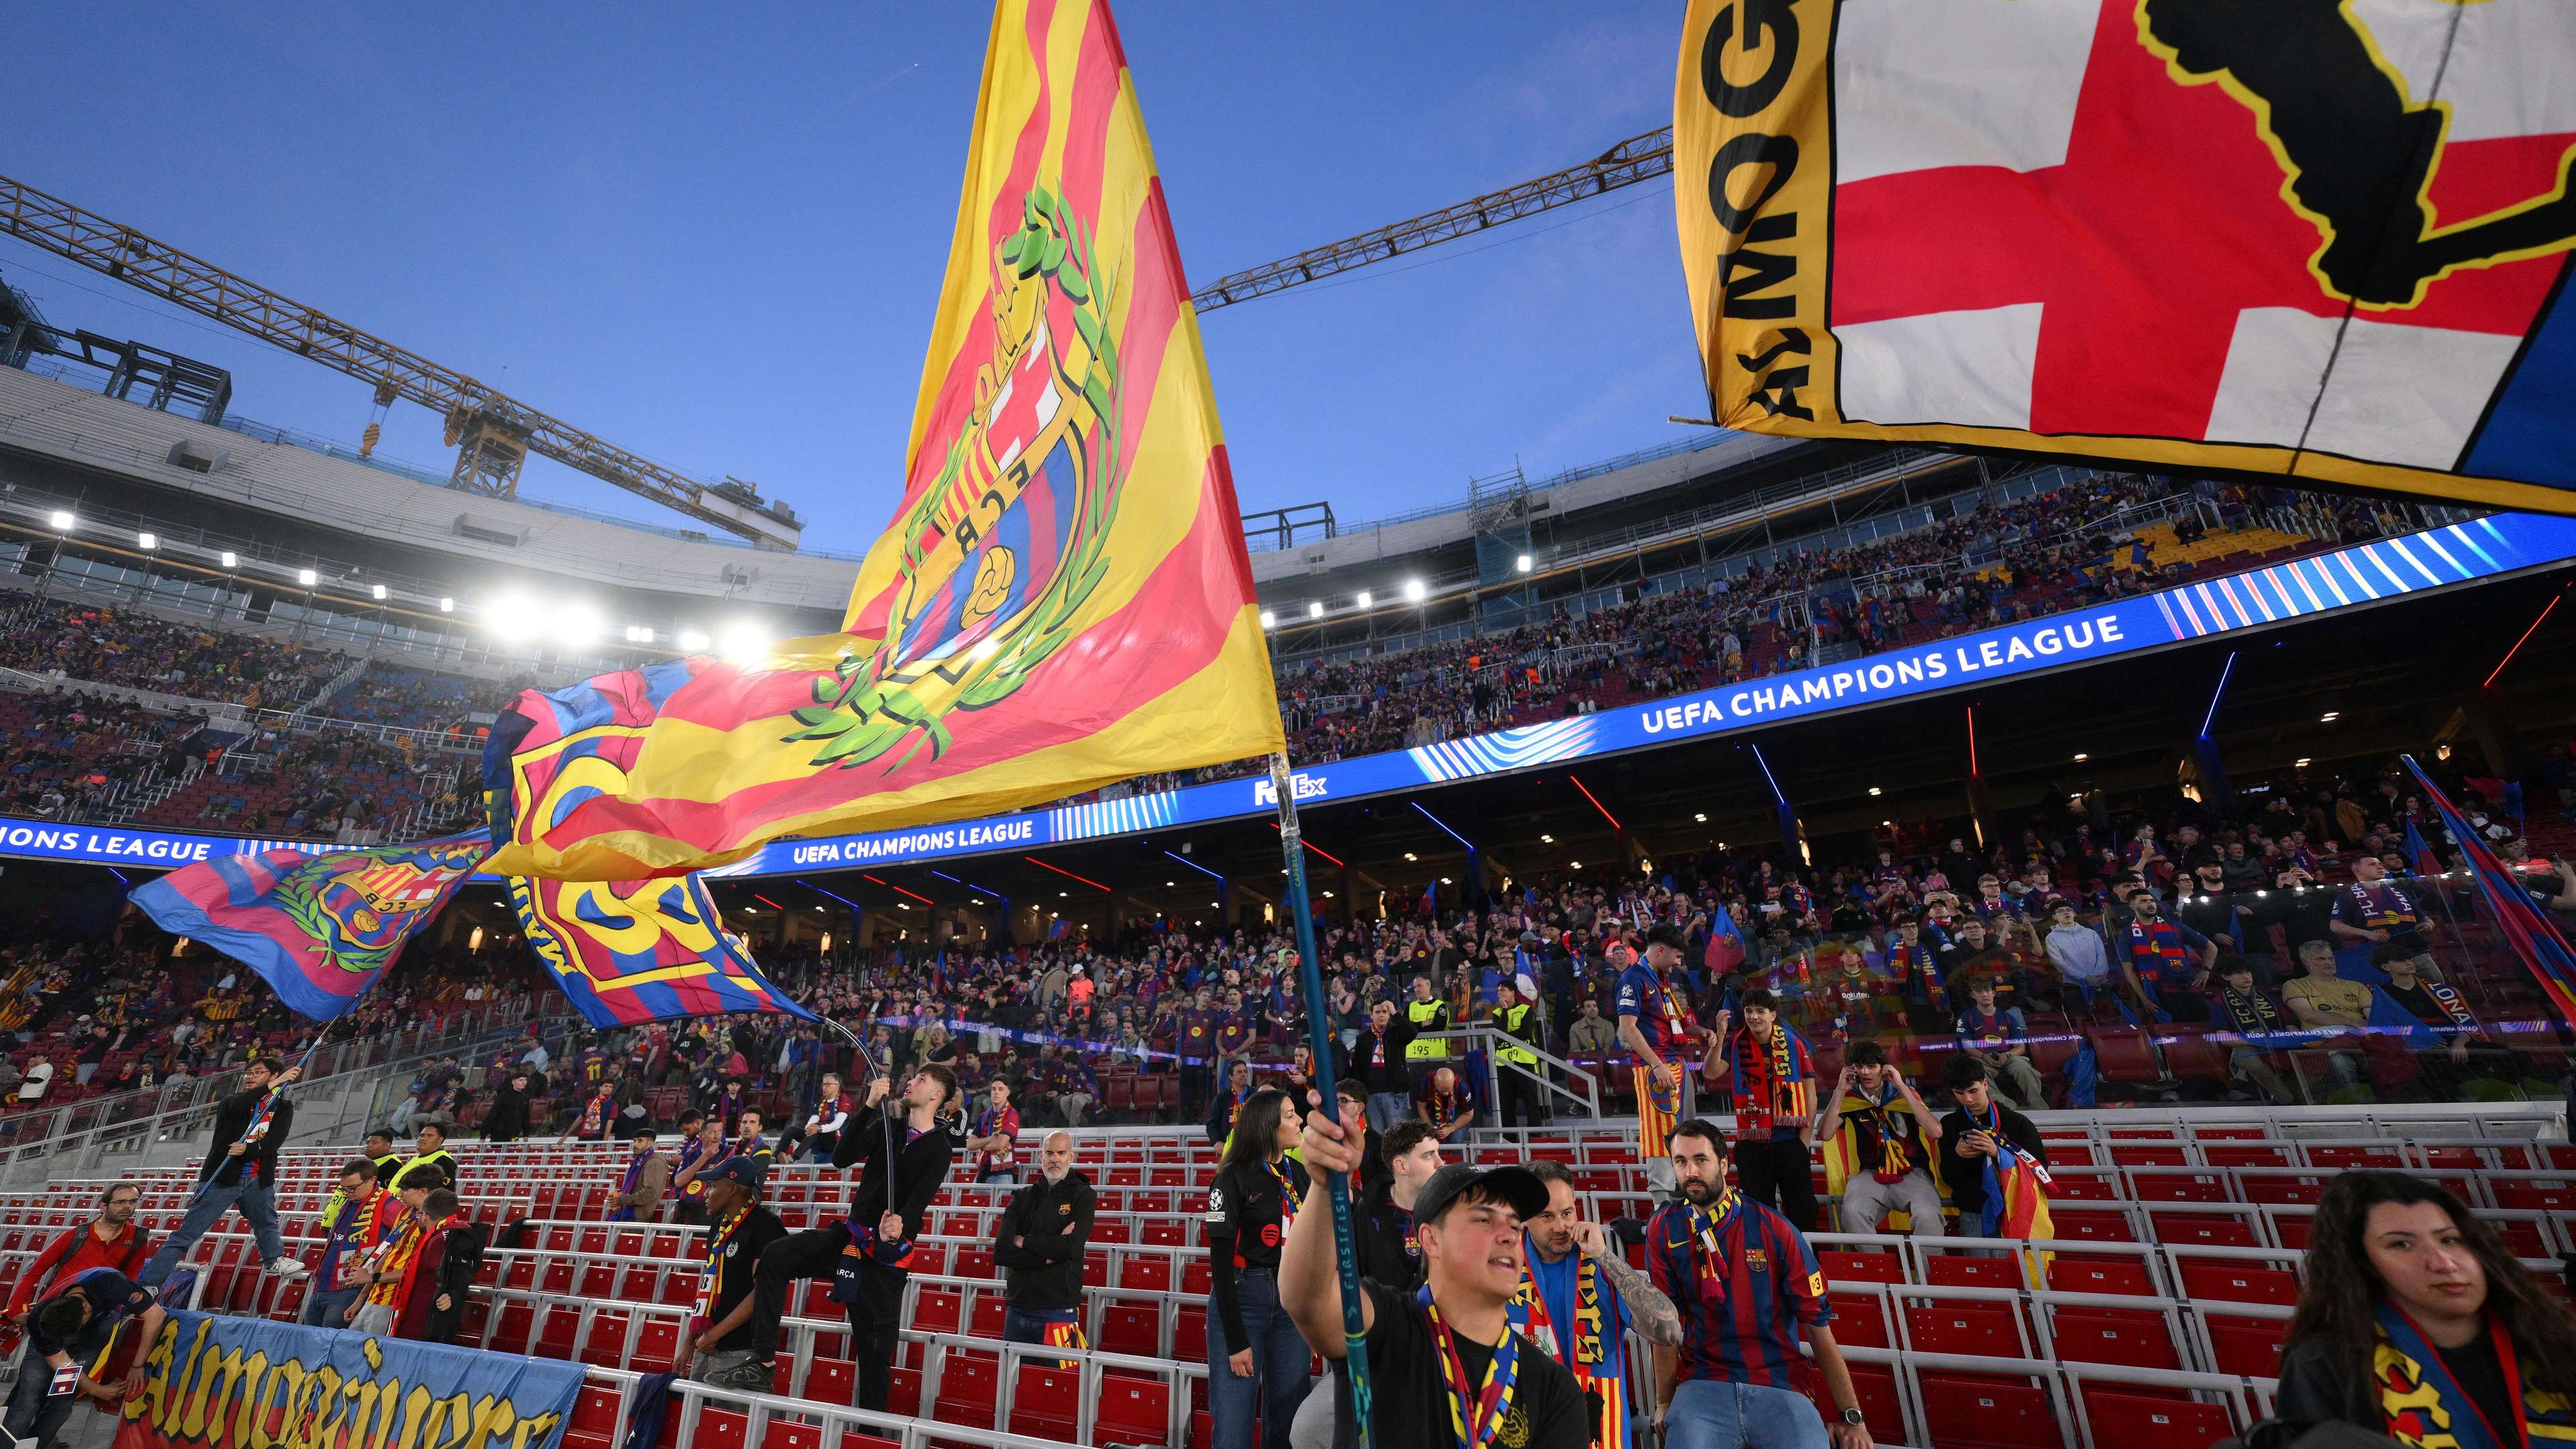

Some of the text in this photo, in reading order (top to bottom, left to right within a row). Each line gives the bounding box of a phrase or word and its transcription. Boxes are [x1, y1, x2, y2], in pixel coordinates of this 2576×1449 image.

[1642, 614, 2125, 734] UEFA CHAMPIONS LEAGUE
[1254, 773, 1328, 806] FeEx
[87, 835, 211, 861] LEAGUE
[794, 820, 1033, 864] UEFA CHAMPIONS LEAGUE
[1841, 991, 1870, 1000] Rakuten
[1413, 1045, 1429, 1055] 195
[587, 1063, 601, 1081] 11
